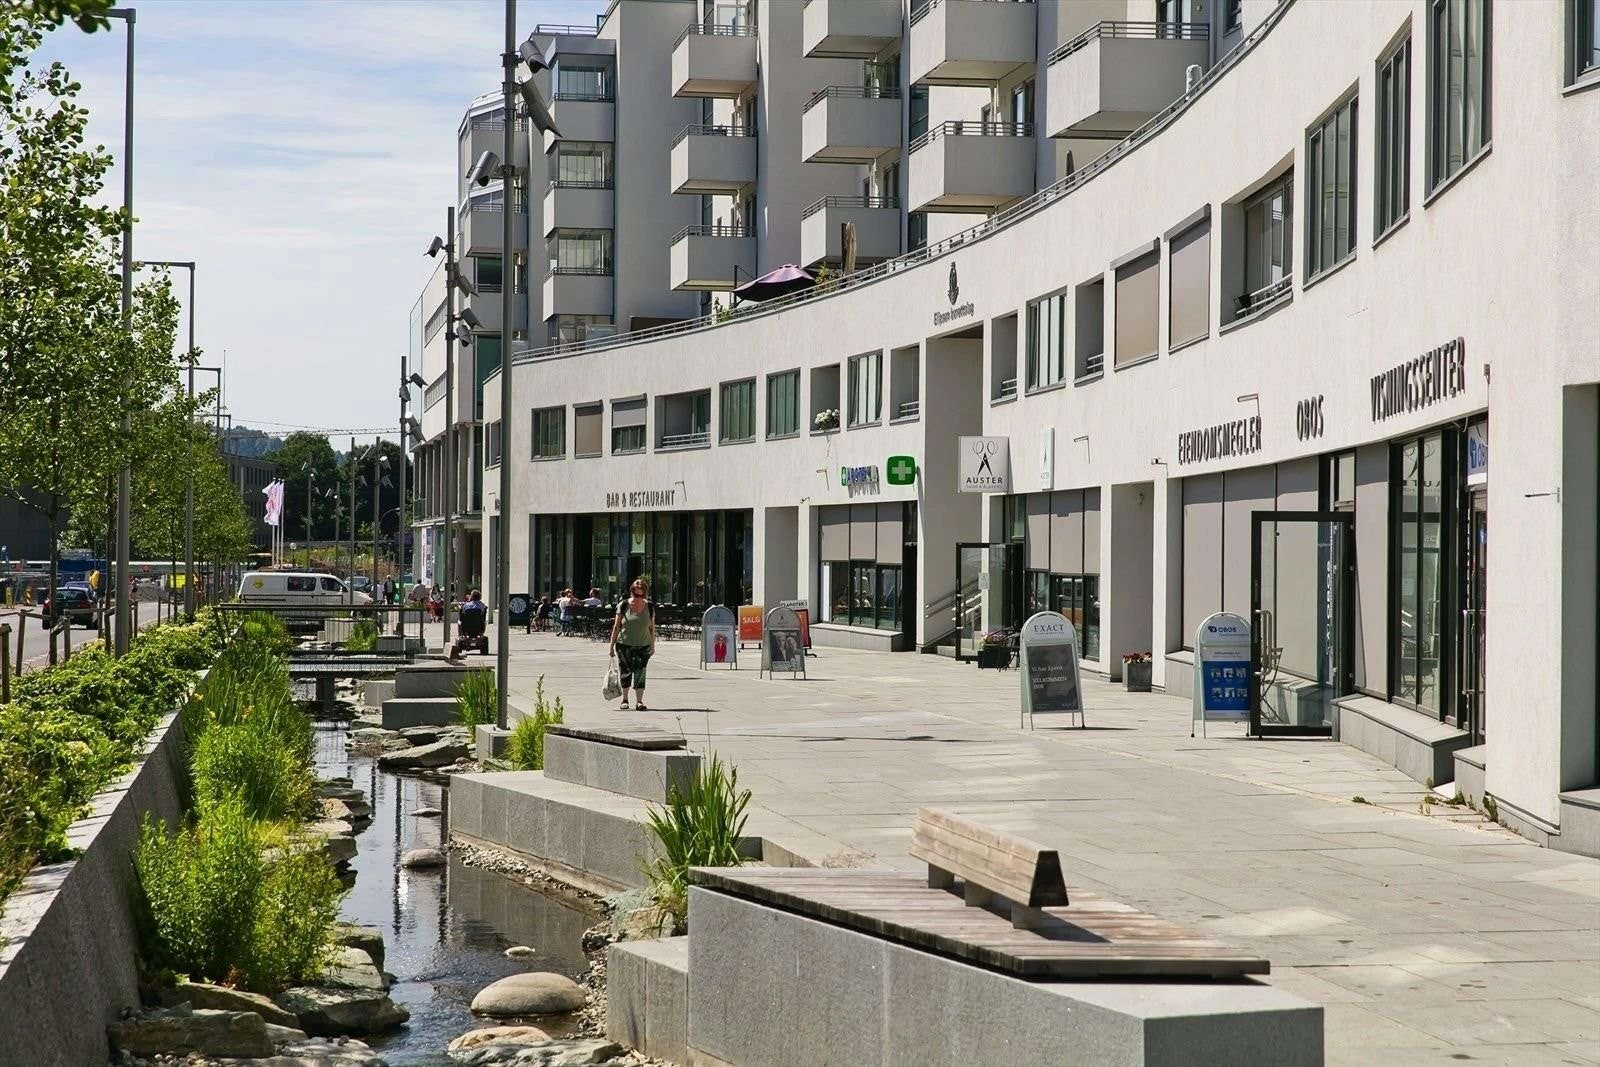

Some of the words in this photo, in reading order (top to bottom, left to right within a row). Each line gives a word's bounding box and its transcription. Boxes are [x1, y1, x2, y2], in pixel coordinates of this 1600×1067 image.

[1370, 336, 1465, 423] VISNINGSSENTER
[1296, 394, 1324, 442] OBOS
[1178, 415, 1262, 466] EIENDOMSMEGLER
[966, 476, 1003, 484] AUSTER
[606, 493, 620, 508] BAR
[622, 492, 627, 508] &
[629, 490, 675, 508] RESTAURANT
[1034, 624, 1064, 632] EXACT
